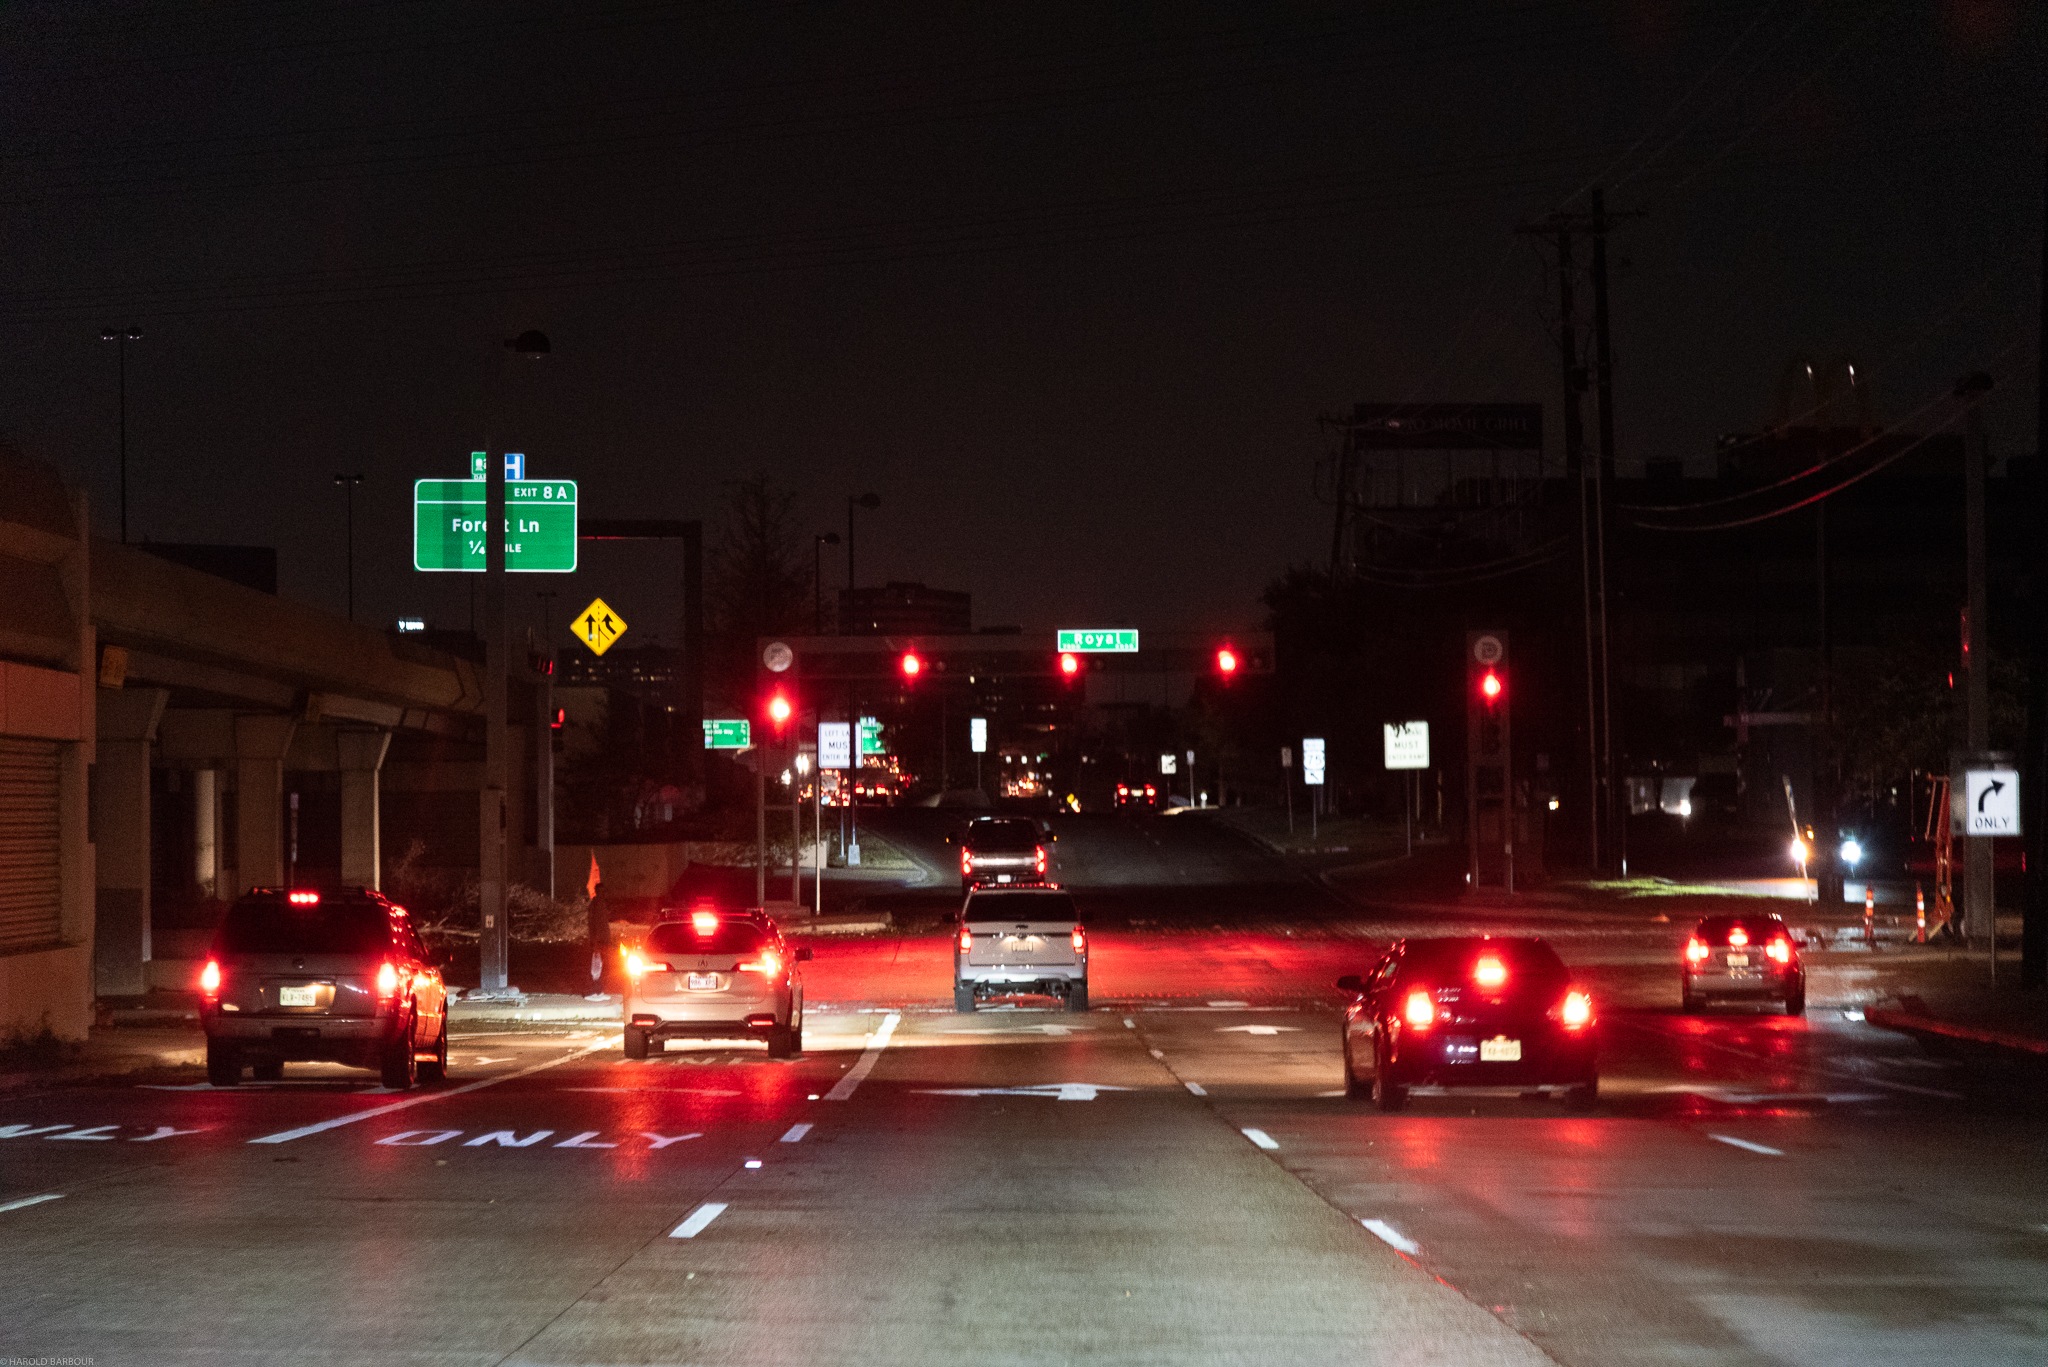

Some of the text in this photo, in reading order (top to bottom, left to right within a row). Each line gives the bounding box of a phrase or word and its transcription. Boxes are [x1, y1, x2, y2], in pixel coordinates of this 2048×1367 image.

[514, 488, 537, 497] EXIT
[452, 519, 539, 533] Foret Ln
[1074, 632, 1120, 647] Royal
[828, 741, 850, 750] MUS
[1394, 741, 1418, 749] MUST
[1975, 816, 2009, 829] ONLY
[0, 1124, 227, 1141] NLY
[374, 1129, 704, 1149] ONLY
